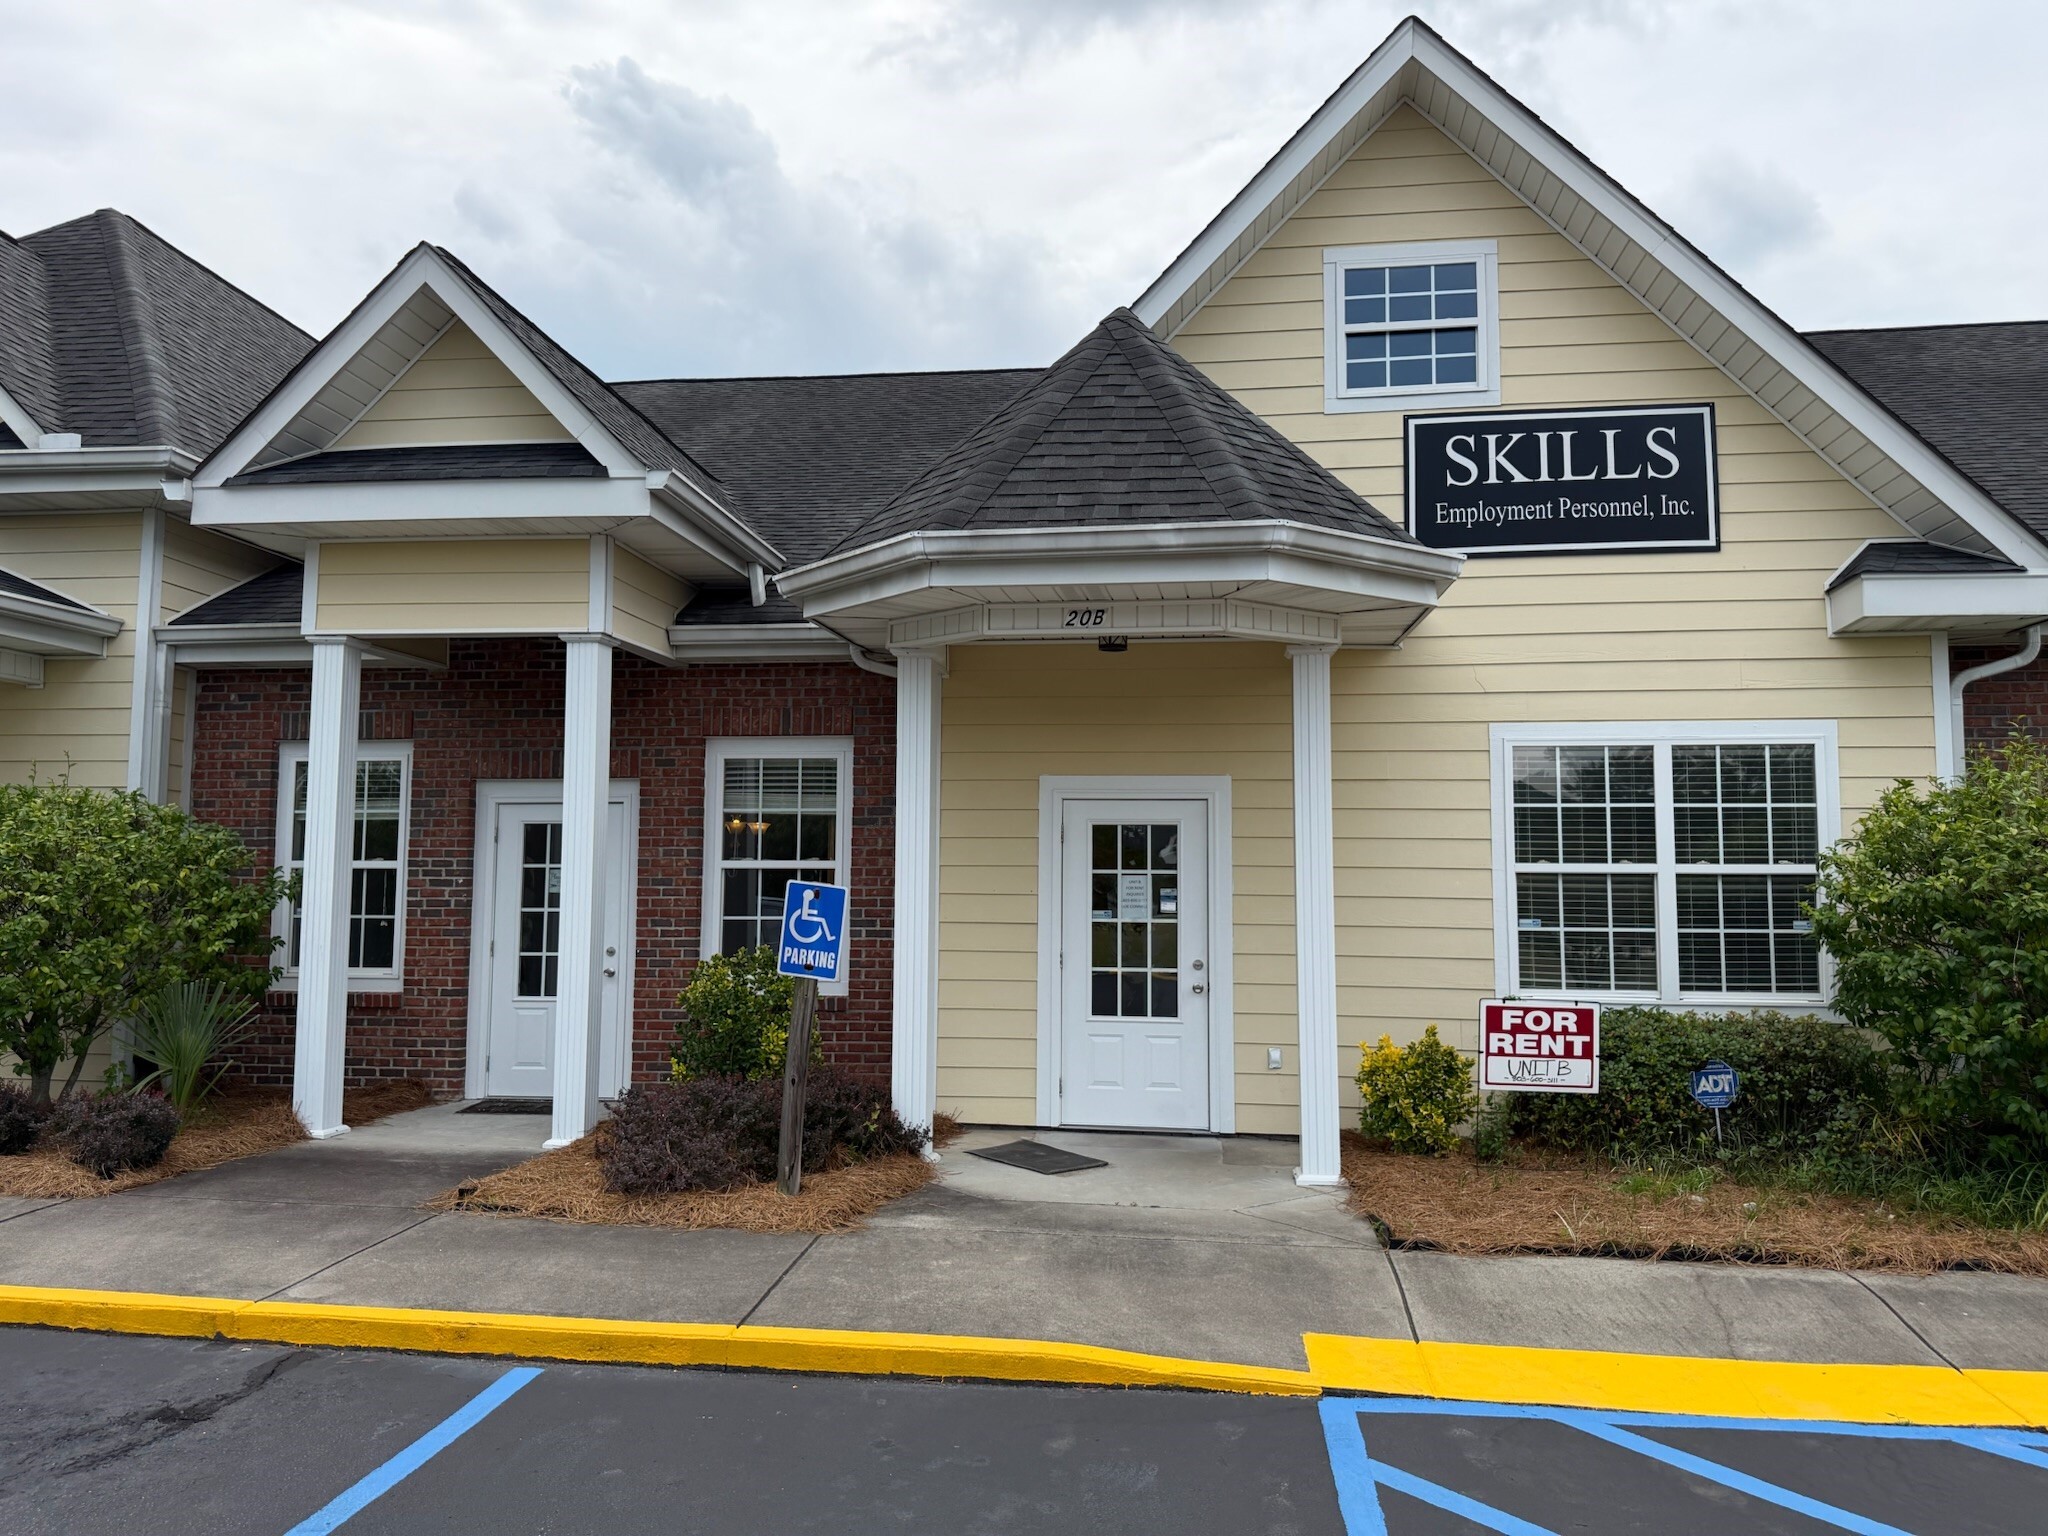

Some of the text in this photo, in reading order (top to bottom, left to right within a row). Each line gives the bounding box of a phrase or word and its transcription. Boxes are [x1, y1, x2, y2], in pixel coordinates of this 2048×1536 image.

[1445, 426, 1680, 487] SKILLS
[1435, 494, 1695, 528] Employment Personnel, Inc.
[1065, 609, 1105, 627] 20B
[783, 946, 836, 970] PARKING
[1502, 1009, 1578, 1032] FOR
[1489, 1032, 1590, 1056] RENT
[1508, 1059, 1572, 1077] UNIT B
[1697, 1073, 1732, 1094] ADT
